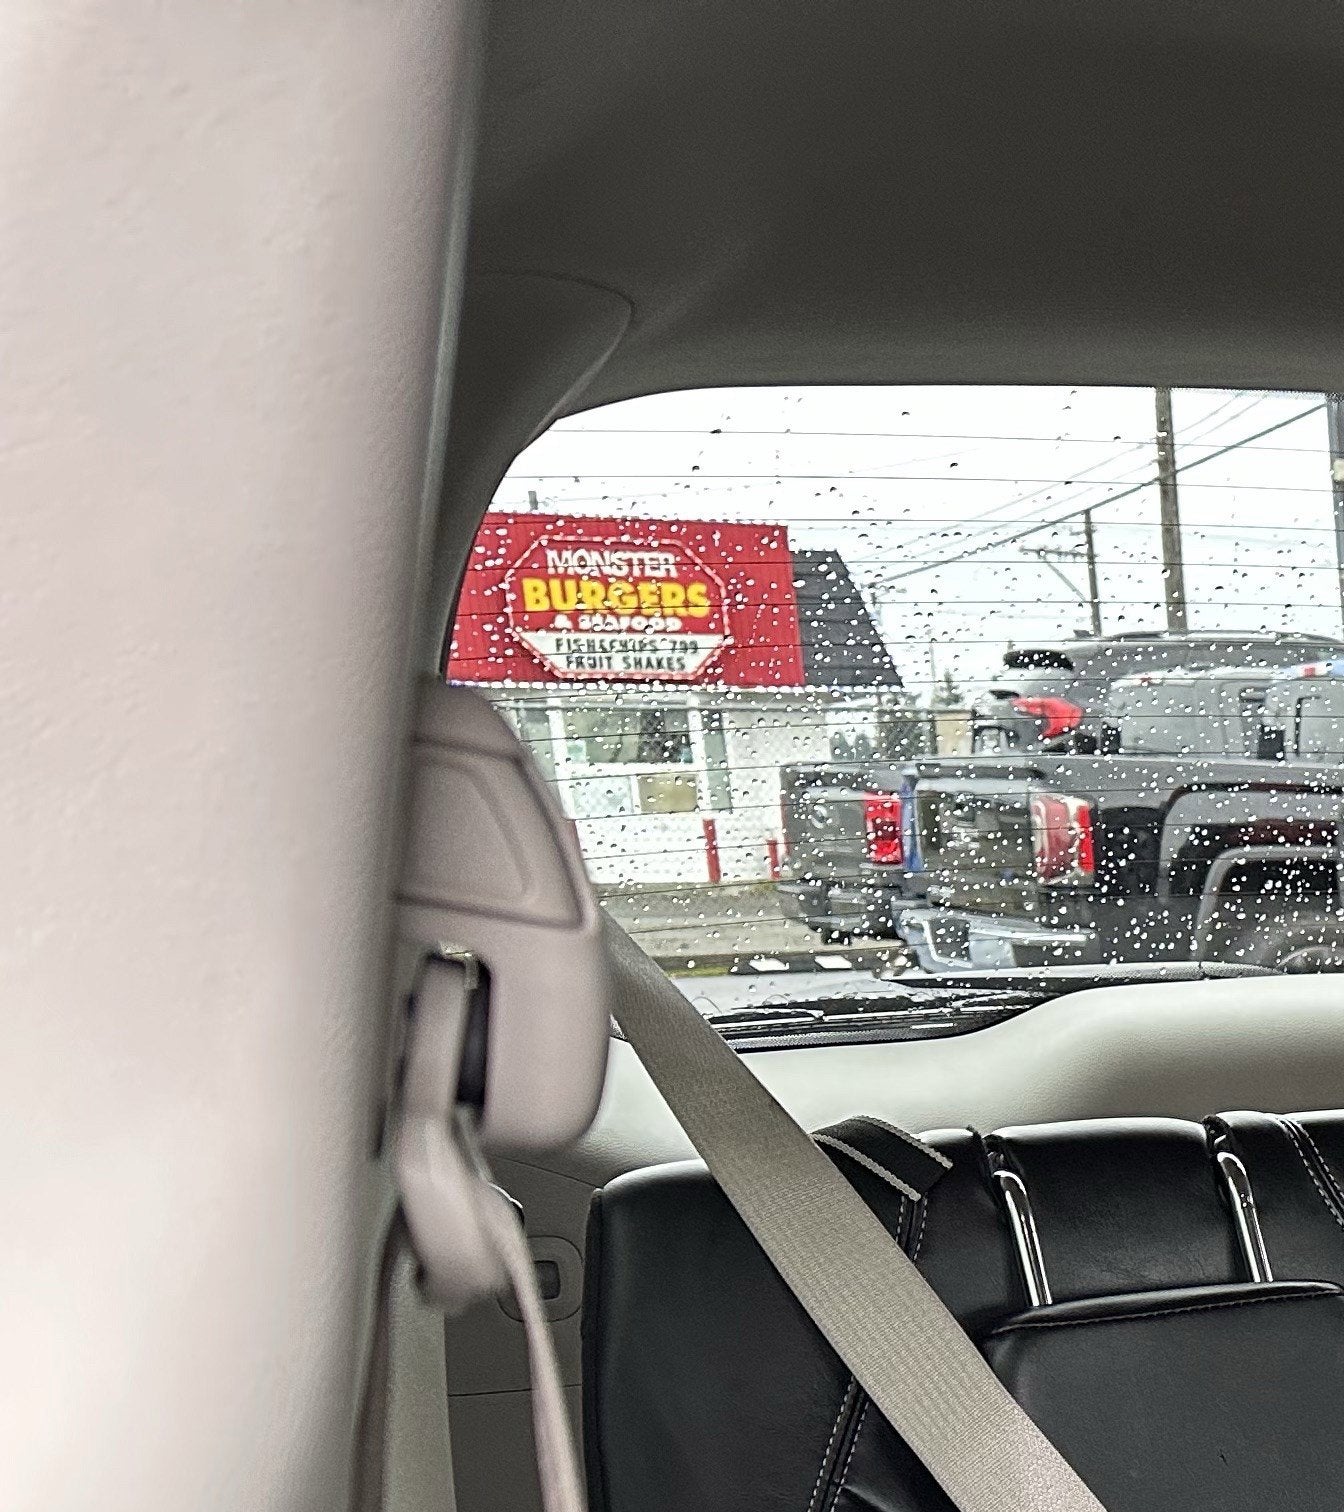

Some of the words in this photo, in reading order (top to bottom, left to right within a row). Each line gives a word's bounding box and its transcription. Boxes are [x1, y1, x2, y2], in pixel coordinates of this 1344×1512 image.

[545, 548, 679, 578] MONSTER
[521, 576, 711, 619] BURGERS
[565, 655, 614, 670] FRUIT
[622, 655, 687, 671] SHAKES
